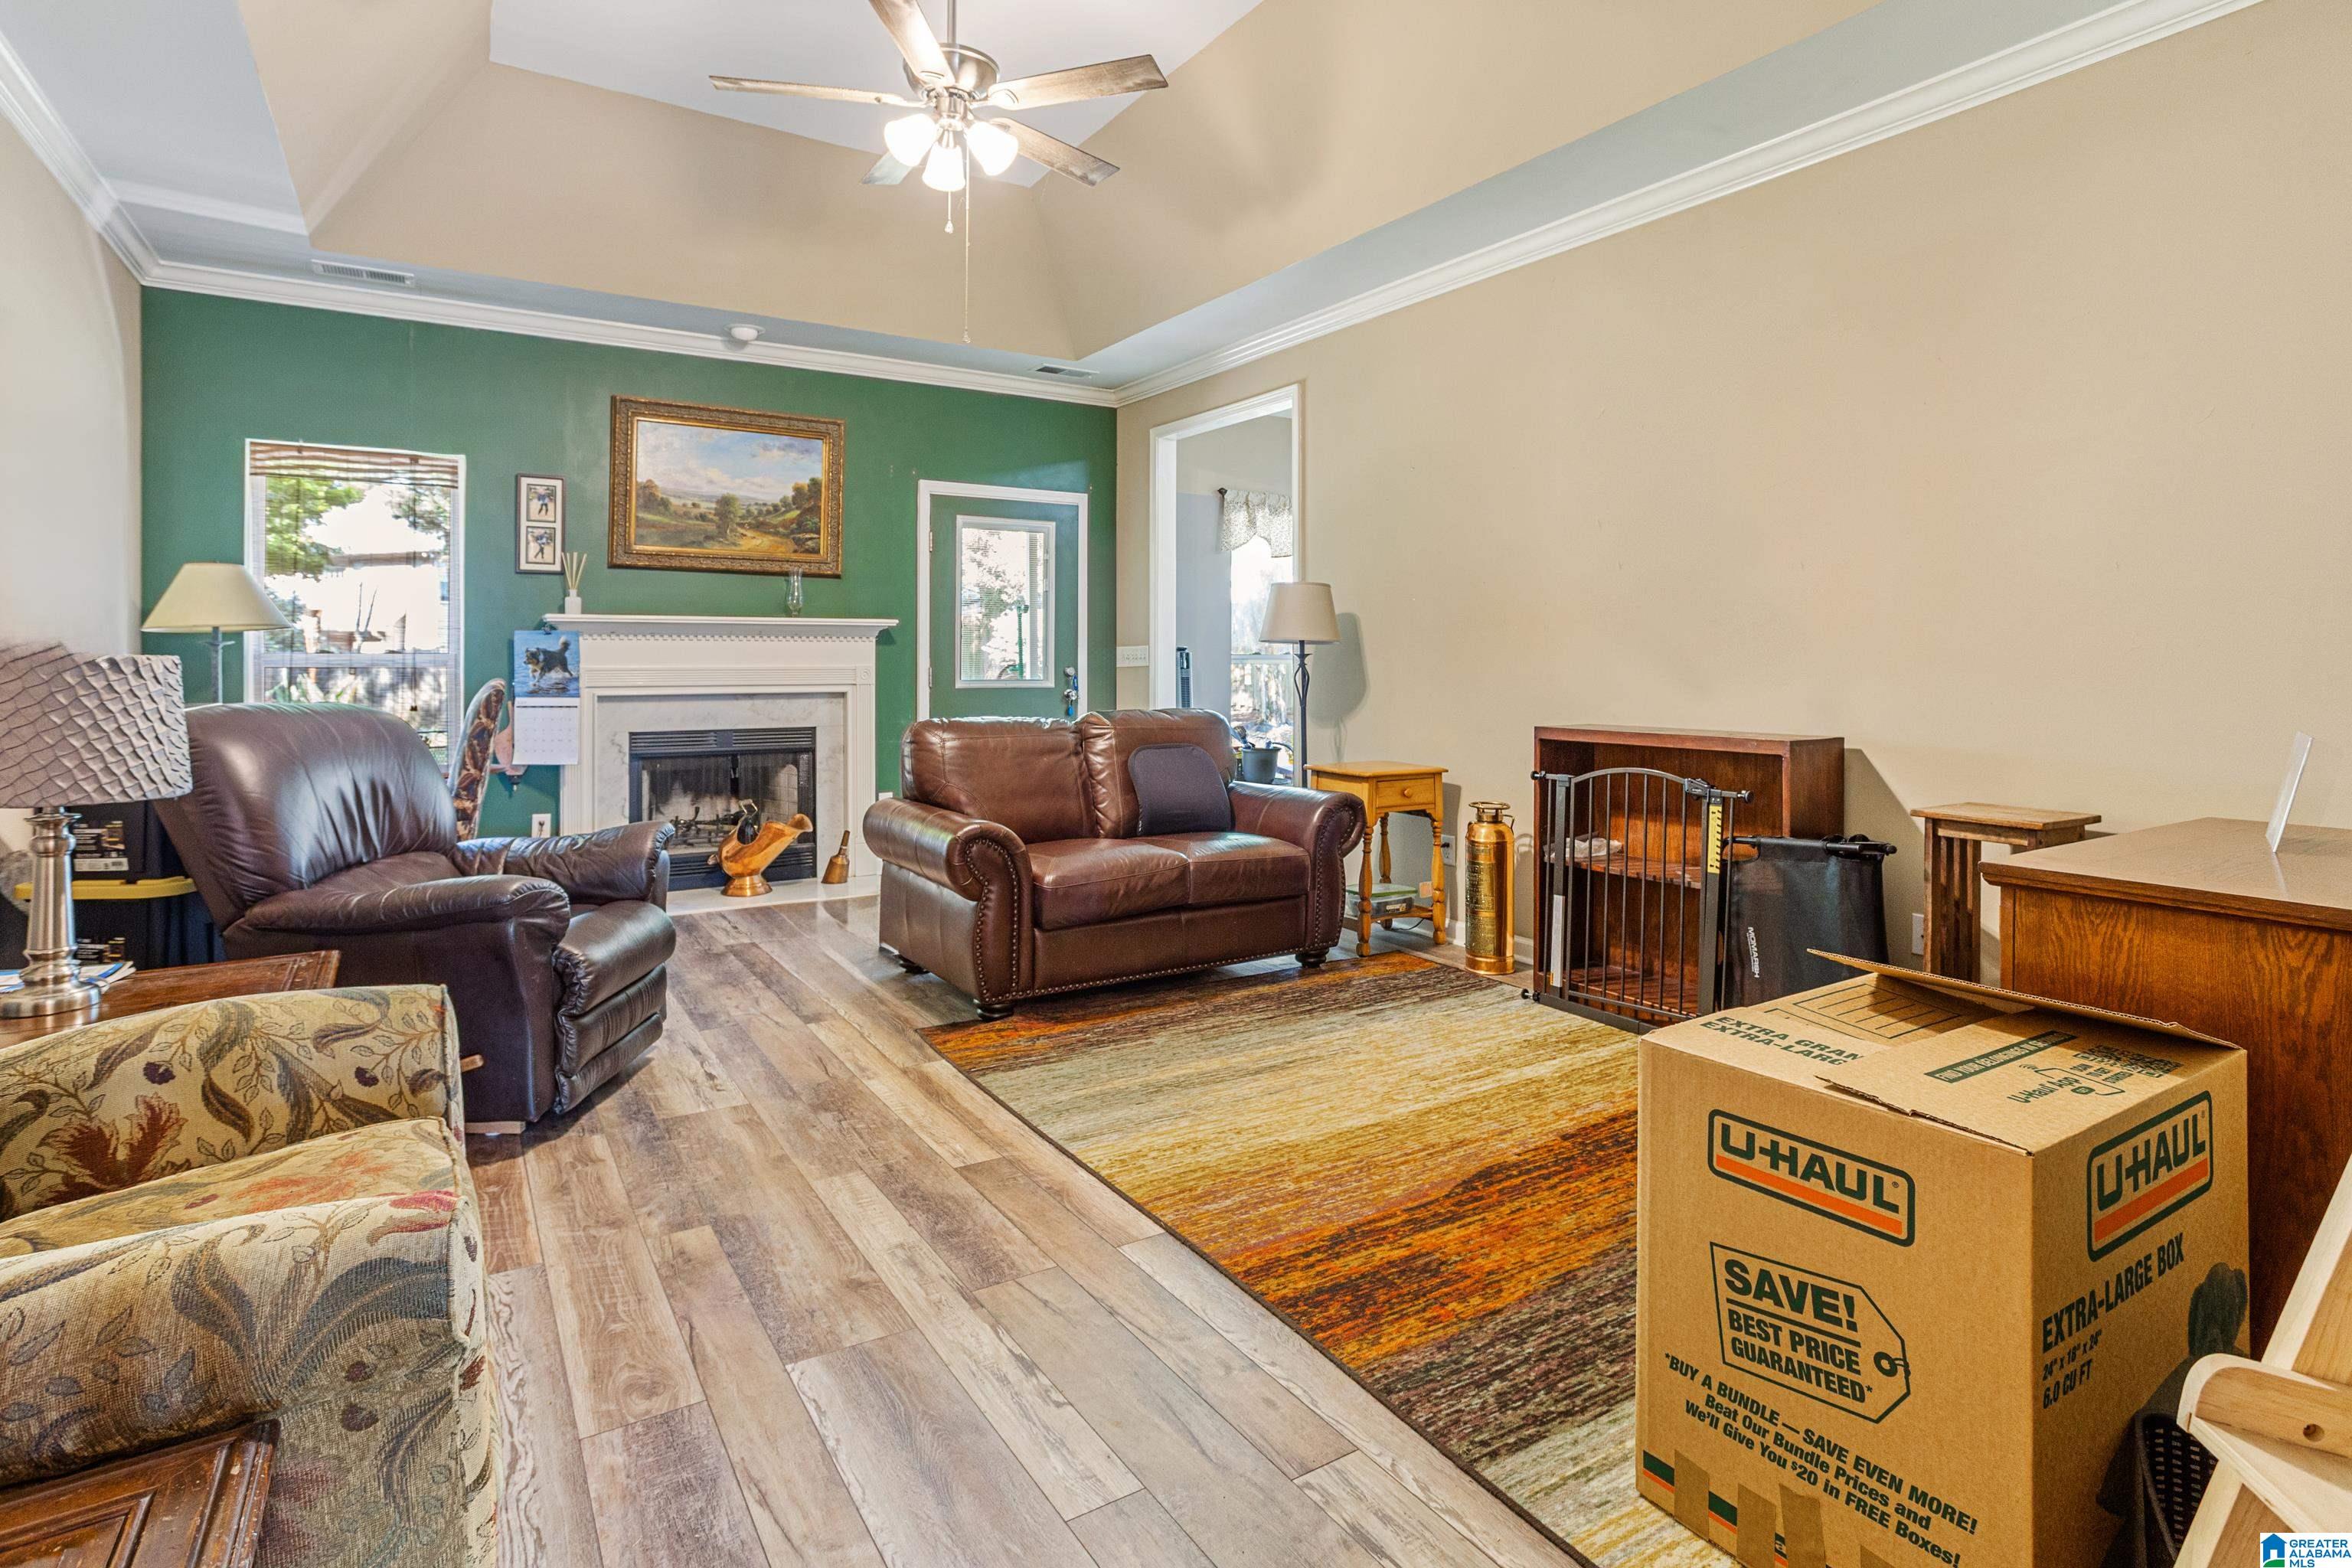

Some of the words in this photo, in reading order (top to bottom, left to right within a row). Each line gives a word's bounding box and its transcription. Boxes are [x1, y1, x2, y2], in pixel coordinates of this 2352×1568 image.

[1714, 1016, 1789, 1040] EXTRA
[1953, 1062, 1985, 1074] YOUR
[2047, 1076, 2082, 1089] App
[1724, 1259, 1858, 1333] SAVE!
[2043, 1253, 2153, 1354] EXTRA-LARGE
[2158, 1233, 2184, 1278] BOX
[1727, 1308, 1783, 1347] BEST
[1788, 1329, 1861, 1376] PRICE
[2043, 1380, 2060, 1410] 6.0
[2063, 1369, 2077, 1396] CU
[2079, 1359, 2093, 1385] FT
[1685, 1400, 1720, 1430] We'll
[1723, 1423, 1755, 1450] Give
[1760, 1442, 1788, 1469] You
[1791, 1461, 1818, 1486] $20
[1822, 1478, 1841, 1501] in
[1844, 1491, 1891, 1529] FREE
[1895, 1519, 1961, 1568] Boxes!
[1700, 1374, 1713, 1390] A
[1717, 1381, 1780, 1427] BUNDLE
[1802, 1428, 1849, 1464] SAVE
[1853, 1455, 1903, 1494] EVEN
[1908, 1485, 1978, 1535] MORE!
[1705, 1393, 1738, 1423] Beat
[1742, 1415, 1769, 1439] Our
[1773, 1431, 1830, 1474] Bundle
[1834, 1465, 1890, 1508] Prices
[1894, 1502, 1932, 1531] and
